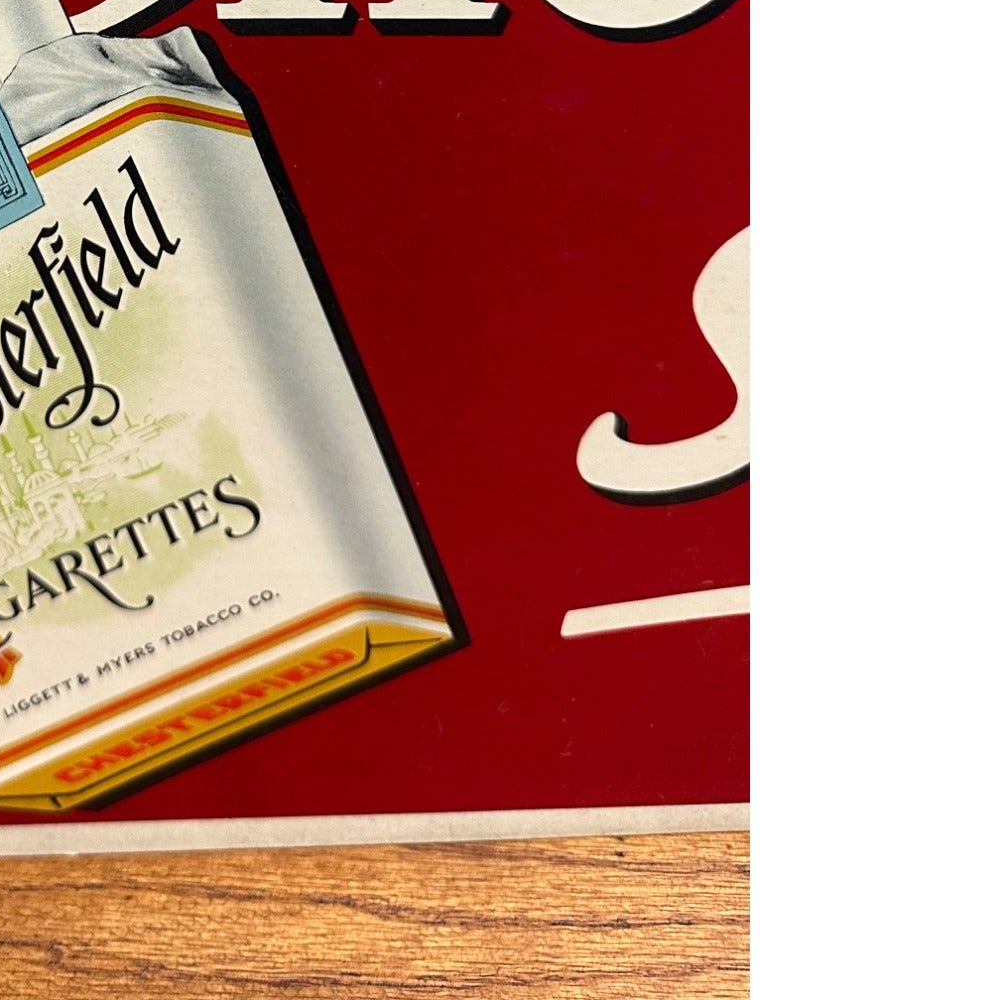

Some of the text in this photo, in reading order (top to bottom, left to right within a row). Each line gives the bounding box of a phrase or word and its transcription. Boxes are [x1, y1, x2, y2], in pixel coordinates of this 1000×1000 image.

[3, 588, 281, 720] LIGGETT & MYERS TOBACCO CO.
[52, 648, 357, 785] CHESTERFIELD
